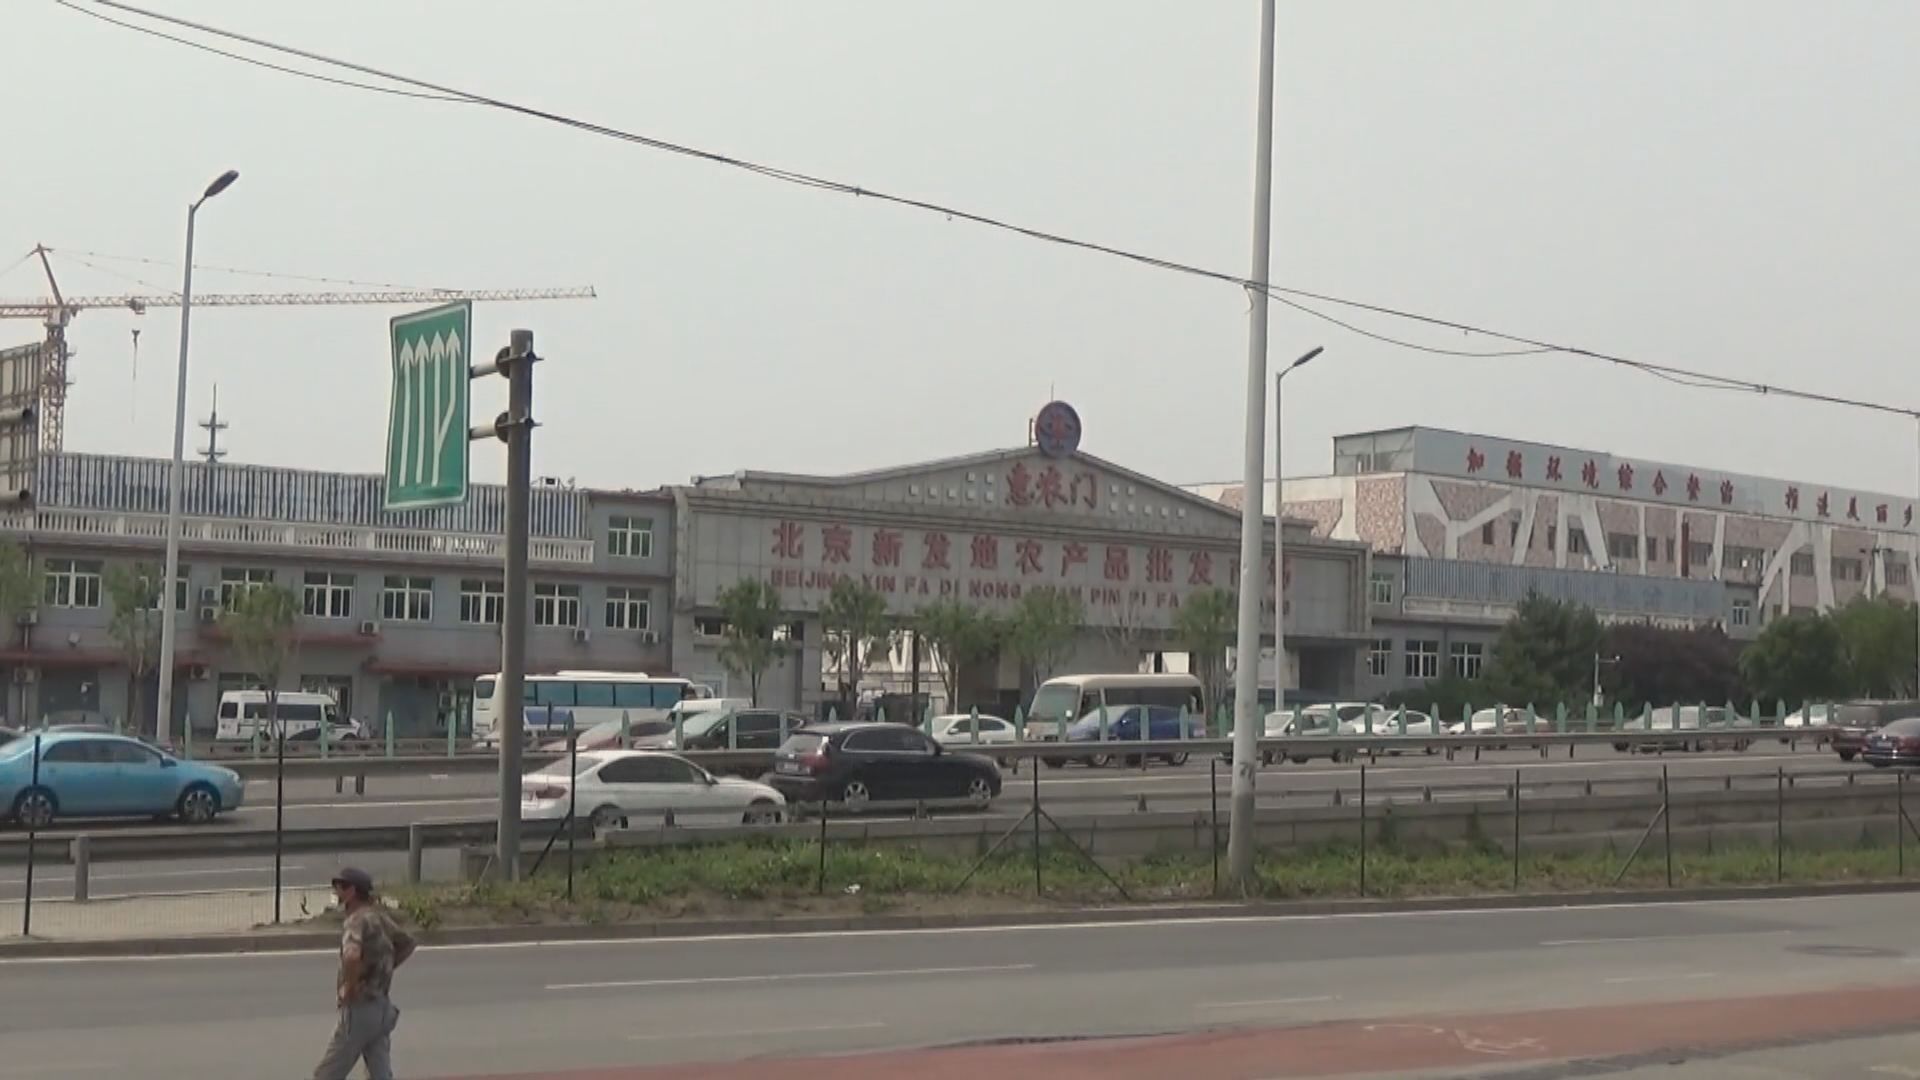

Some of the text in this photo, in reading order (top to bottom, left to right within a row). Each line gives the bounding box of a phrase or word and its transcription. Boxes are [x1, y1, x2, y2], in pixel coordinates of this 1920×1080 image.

[771, 569, 850, 592] BEIJIN
[904, 575, 930, 596] FA
[940, 577, 960, 597] DI
[969, 579, 1021, 599] NONG
